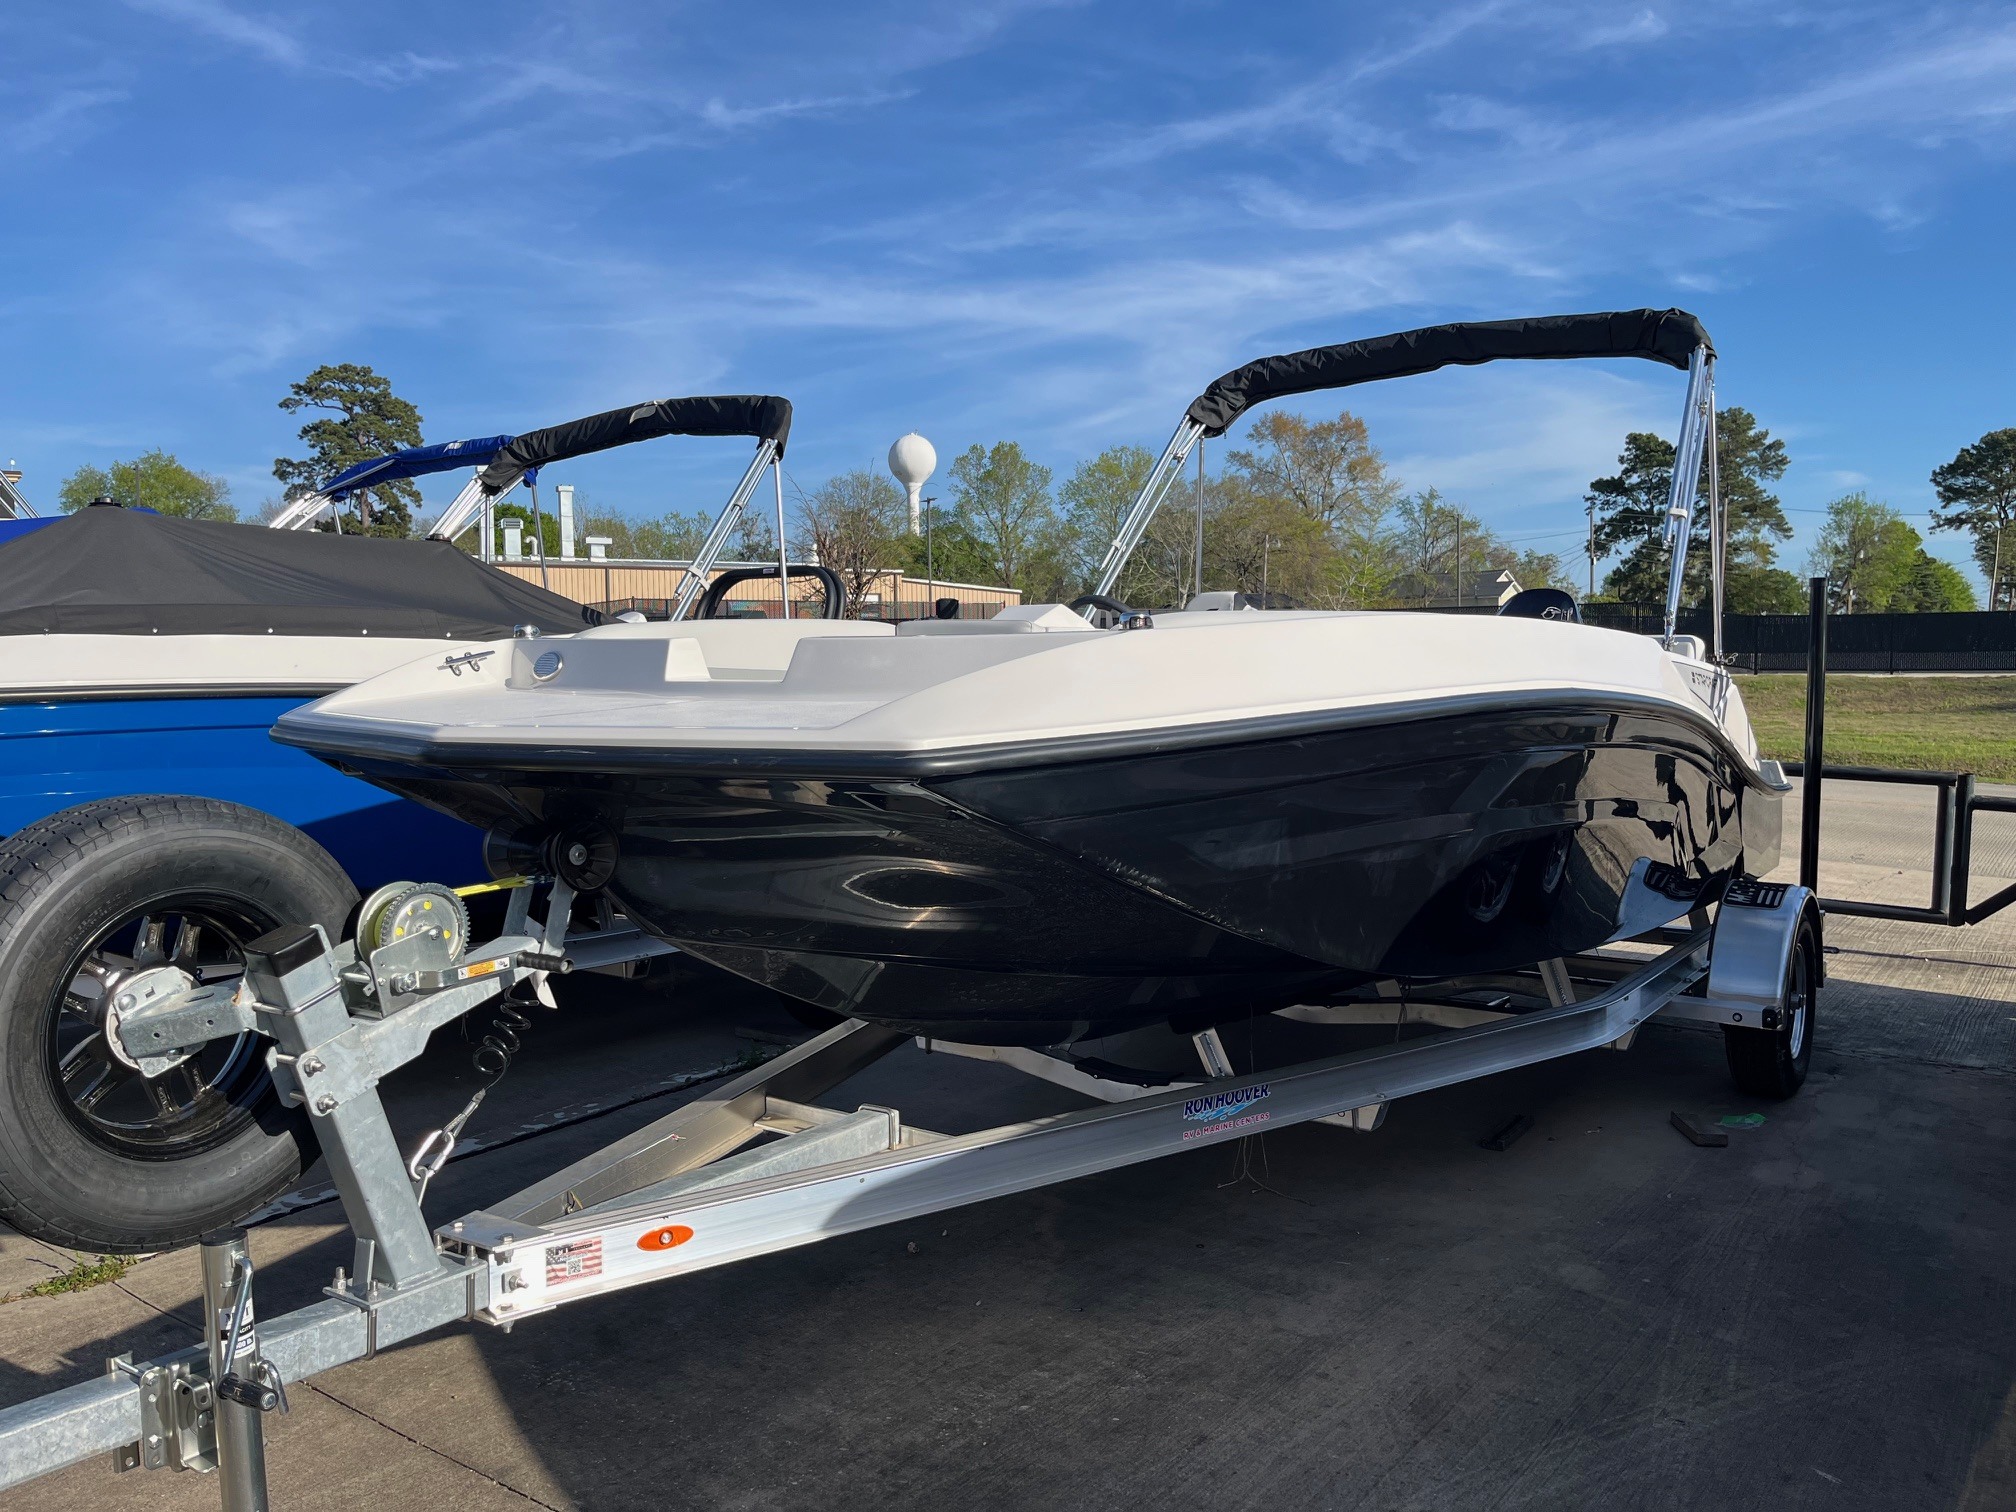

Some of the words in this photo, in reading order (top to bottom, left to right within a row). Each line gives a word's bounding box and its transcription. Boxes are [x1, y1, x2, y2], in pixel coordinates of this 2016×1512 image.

[1184, 1097, 1214, 1117] RON
[1215, 1084, 1270, 1109] HOOVER
[1183, 1130, 1196, 1140] RV
[1195, 1128, 1201, 1137] &
[1203, 1121, 1233, 1136] MARINE
[1235, 1112, 1270, 1128] CENTERS
